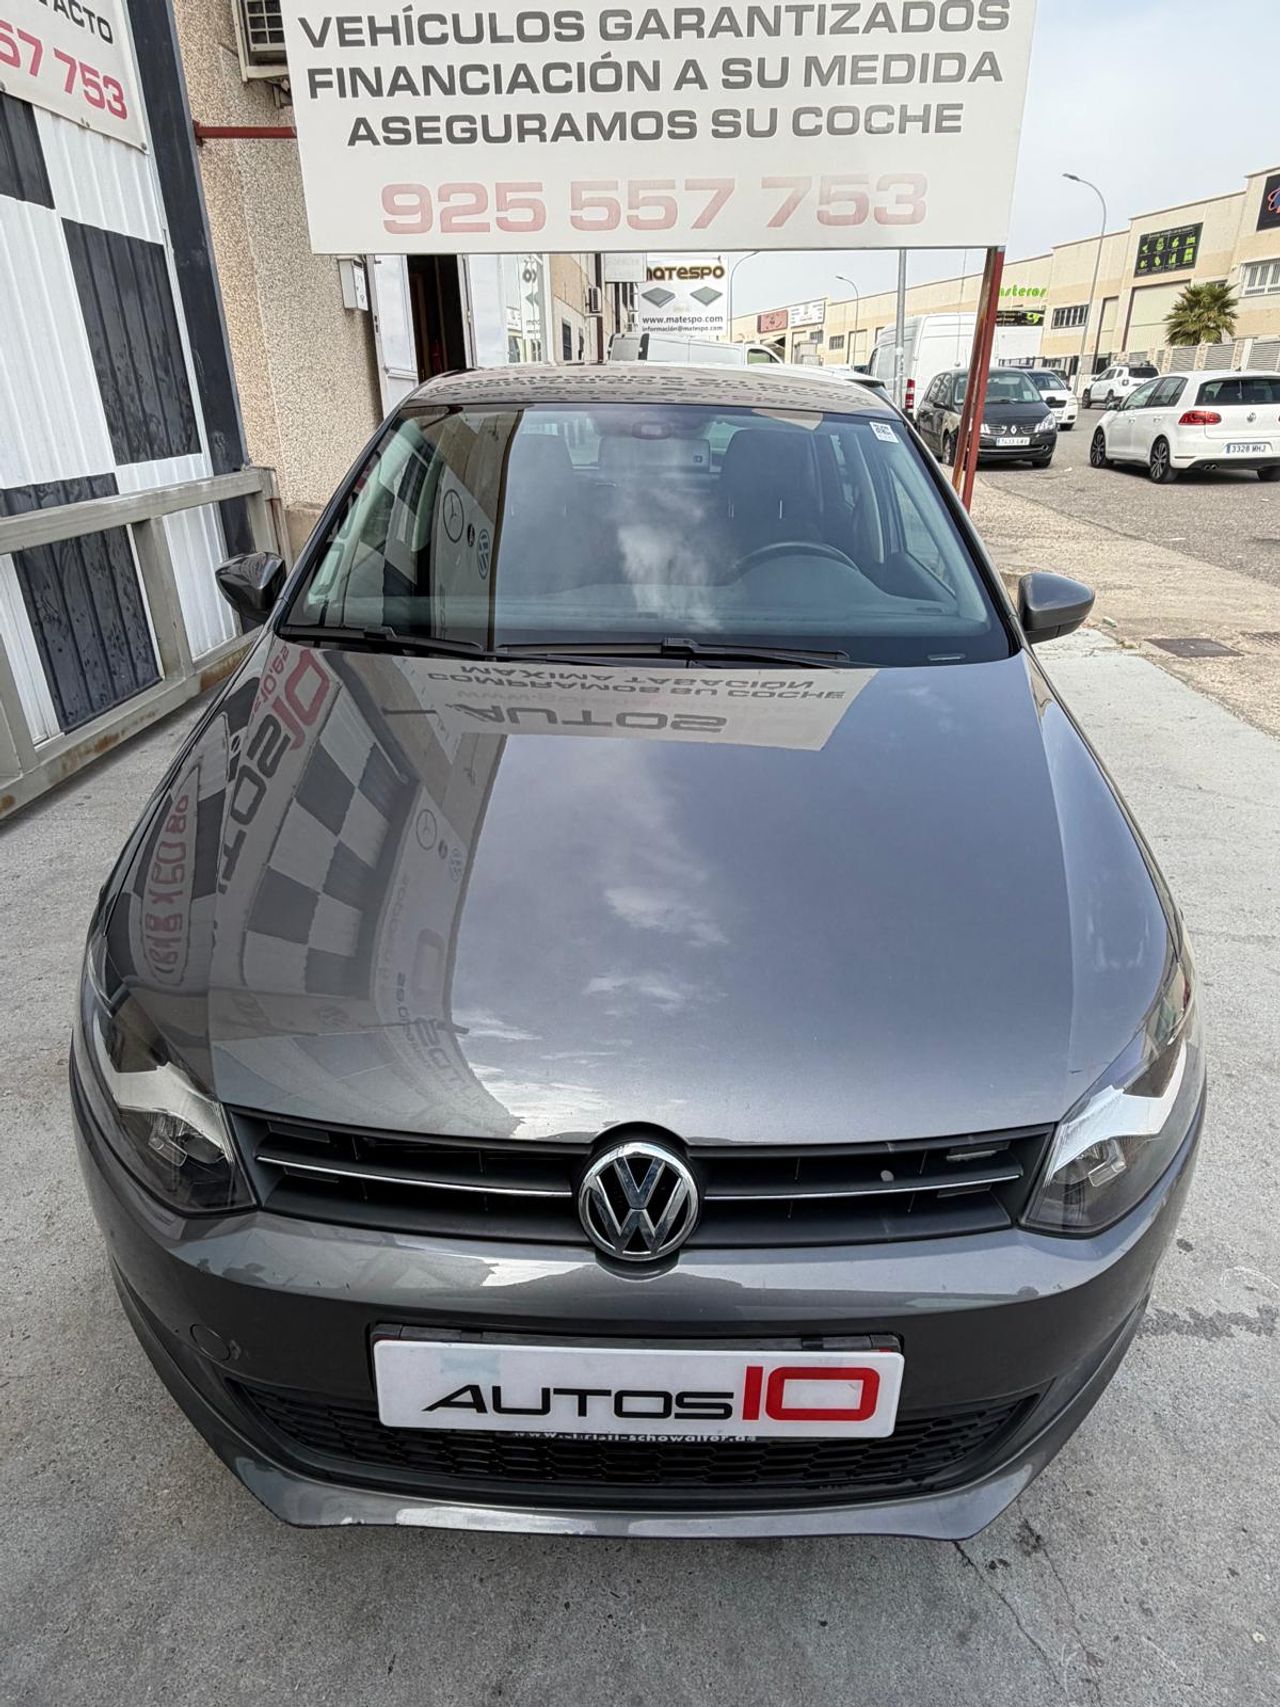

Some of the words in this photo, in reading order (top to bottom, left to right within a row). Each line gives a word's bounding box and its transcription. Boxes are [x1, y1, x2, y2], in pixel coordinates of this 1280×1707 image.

[297, 4, 585, 49] VEHÍCULOS
[599, 0, 1010, 42] GARANTIZADOS
[53, 47, 128, 120] 753
[307, 51, 661, 100] FINANCIACIÓN
[673, 59, 709, 91] A
[721, 56, 790, 90] SU
[803, 51, 1003, 88] MEDIDA
[347, 108, 698, 147] ASEGURAMOS
[711, 107, 778, 139] SU
[792, 103, 964, 137] COCHE
[381, 182, 546, 234] 925
[570, 177, 735, 232] 557
[760, 172, 927, 228] 753
[642, 315, 724, 325] www.matespo.com
